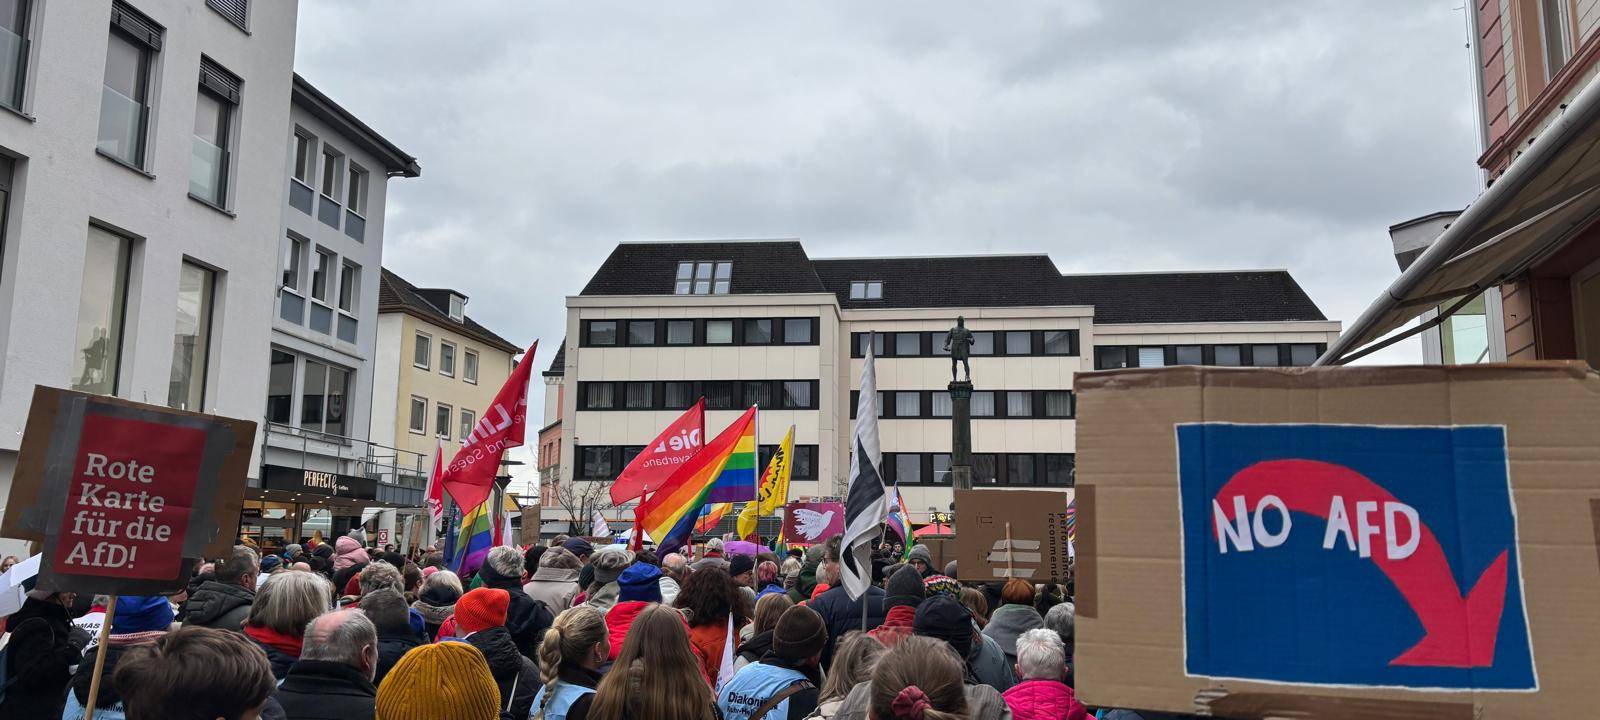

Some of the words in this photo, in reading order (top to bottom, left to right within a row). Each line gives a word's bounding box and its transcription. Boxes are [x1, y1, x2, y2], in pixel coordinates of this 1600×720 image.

[84, 453, 155, 483] Rote
[303, 471, 332, 489] PERFECT
[77, 482, 166, 513] Karte
[71, 510, 122, 538] für
[126, 514, 171, 542] die
[1211, 494, 1293, 554] NO
[1322, 494, 1421, 560] AFD
[64, 541, 137, 569] AfD!
